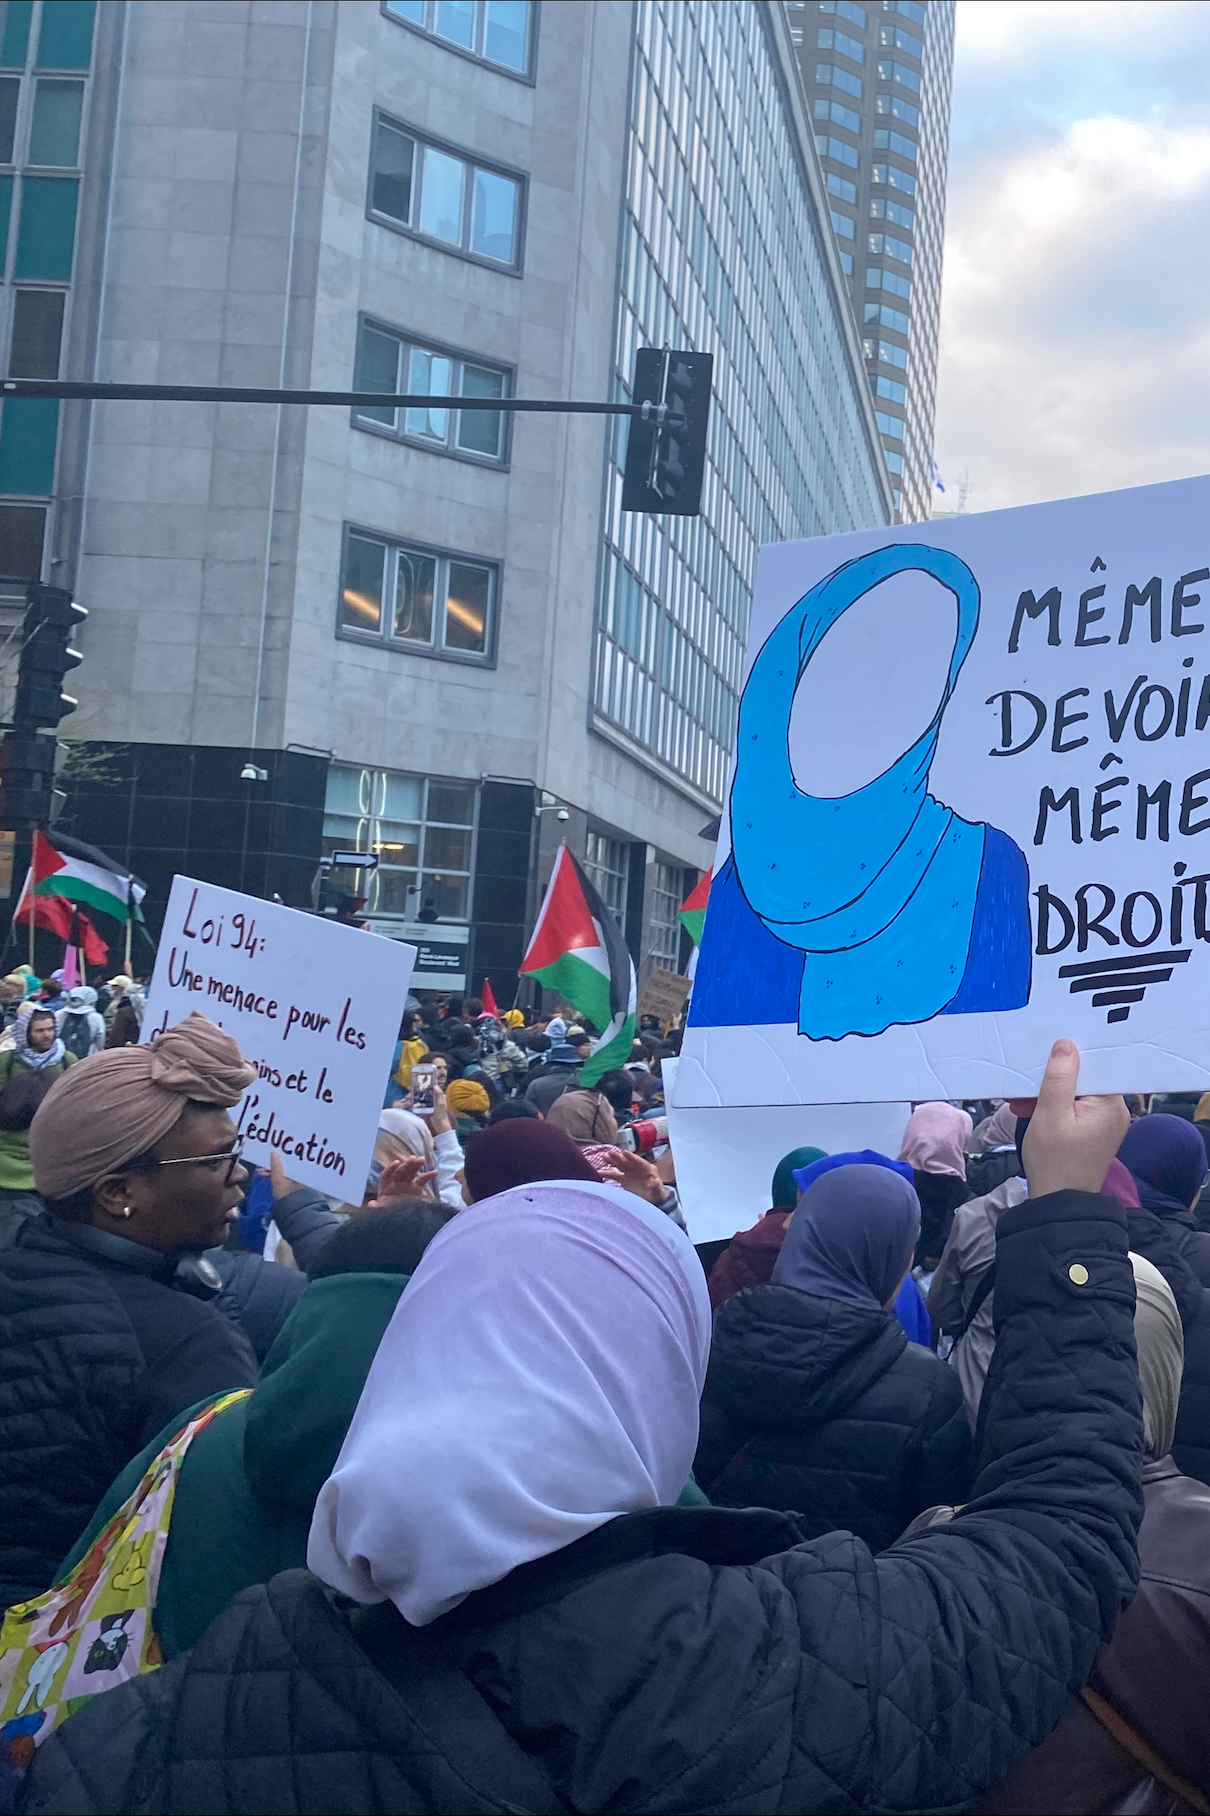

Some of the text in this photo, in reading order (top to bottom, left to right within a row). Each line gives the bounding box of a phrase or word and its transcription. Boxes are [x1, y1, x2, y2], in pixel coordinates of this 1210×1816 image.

[183, 888, 266, 958] Loi 94:
[168, 947, 366, 1050] Une menace pour les
[285, 1069, 308, 1092] et
[315, 1067, 333, 1103] le
